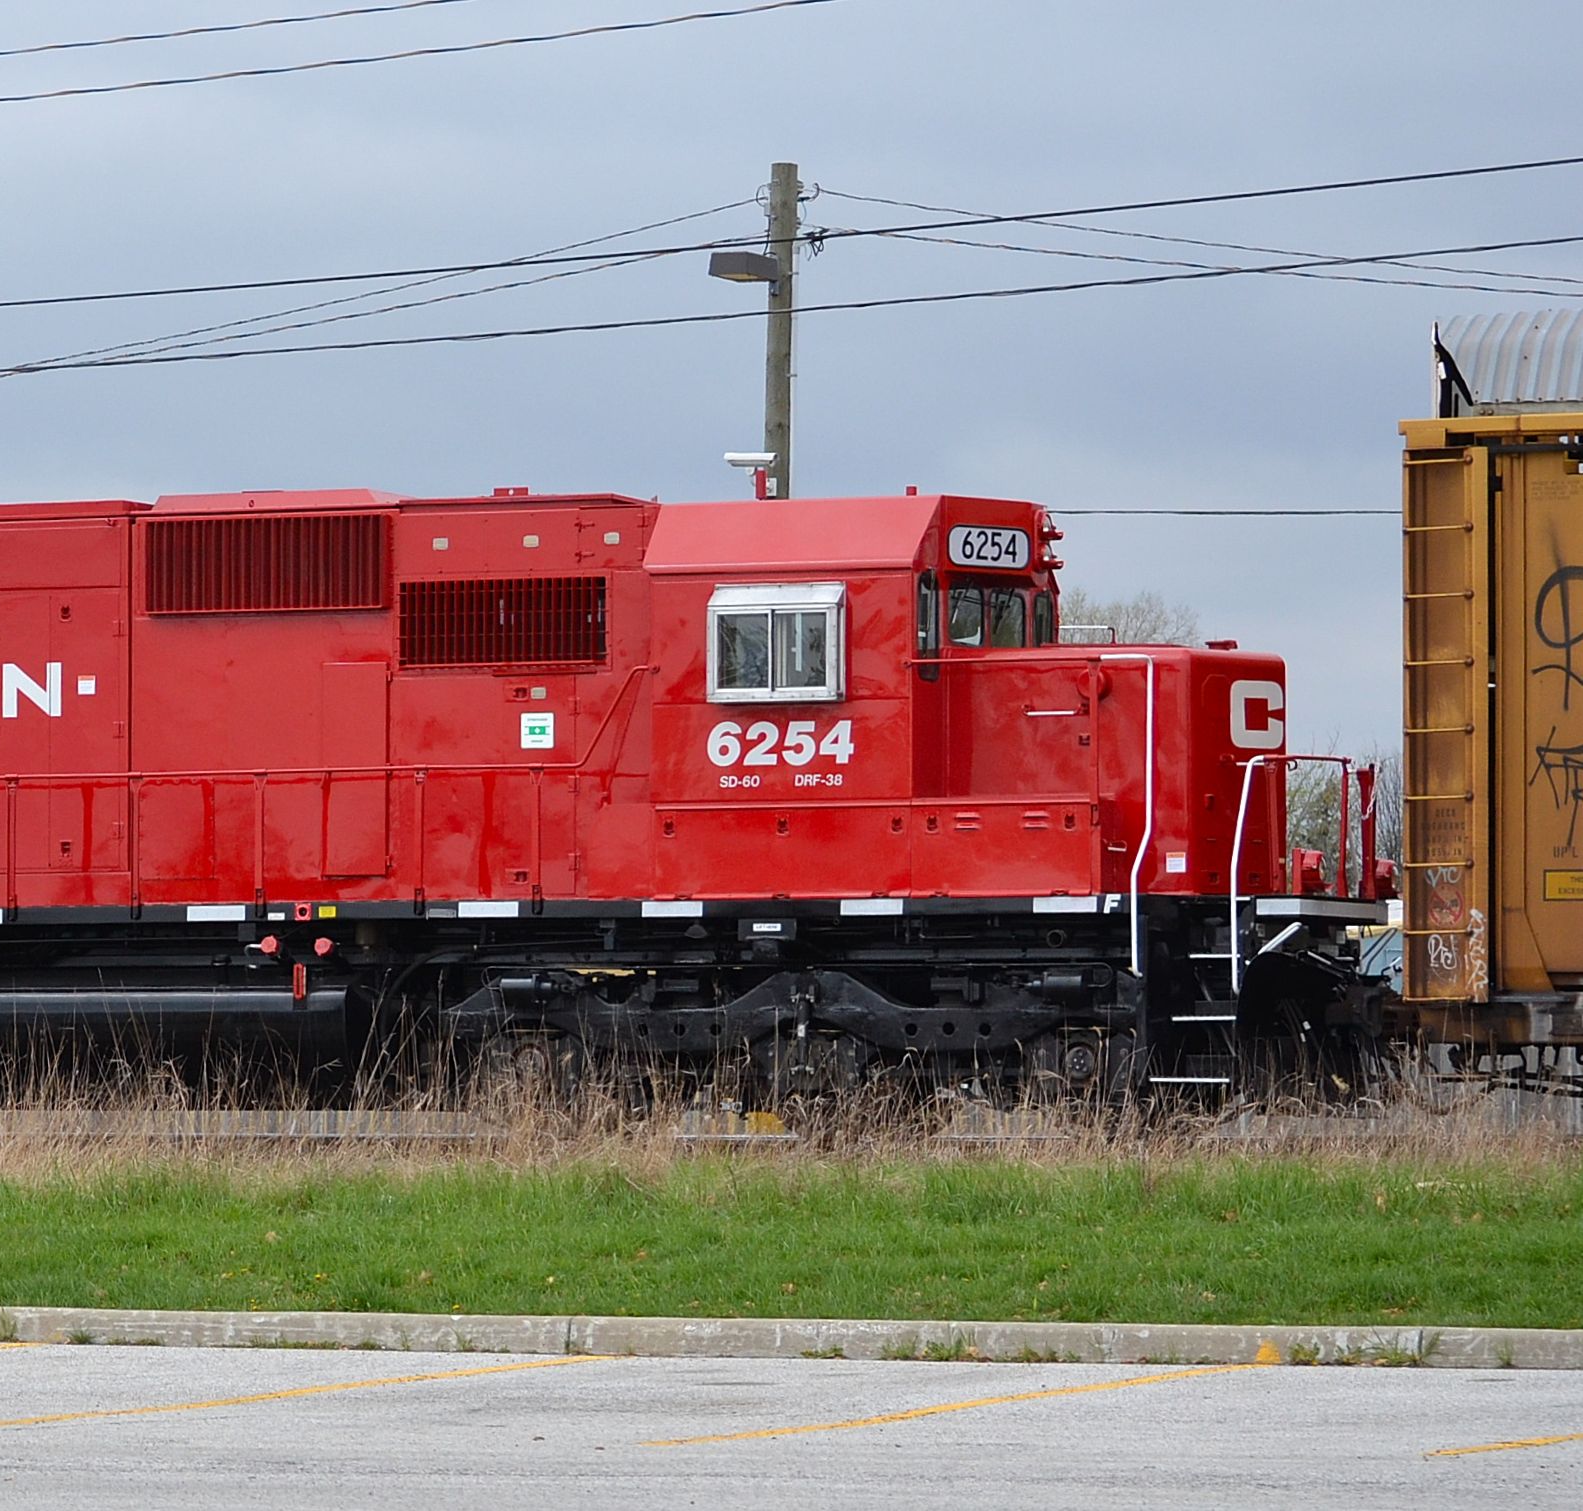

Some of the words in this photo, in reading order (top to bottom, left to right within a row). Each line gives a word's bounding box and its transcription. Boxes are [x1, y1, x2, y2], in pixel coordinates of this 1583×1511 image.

[962, 530, 1017, 563] 6254
[1230, 680, 1284, 749] C
[707, 719, 854, 767] 6254
[719, 775, 761, 788] SD-60
[794, 774, 843, 787] DRF-38
[1103, 894, 1121, 914] F
